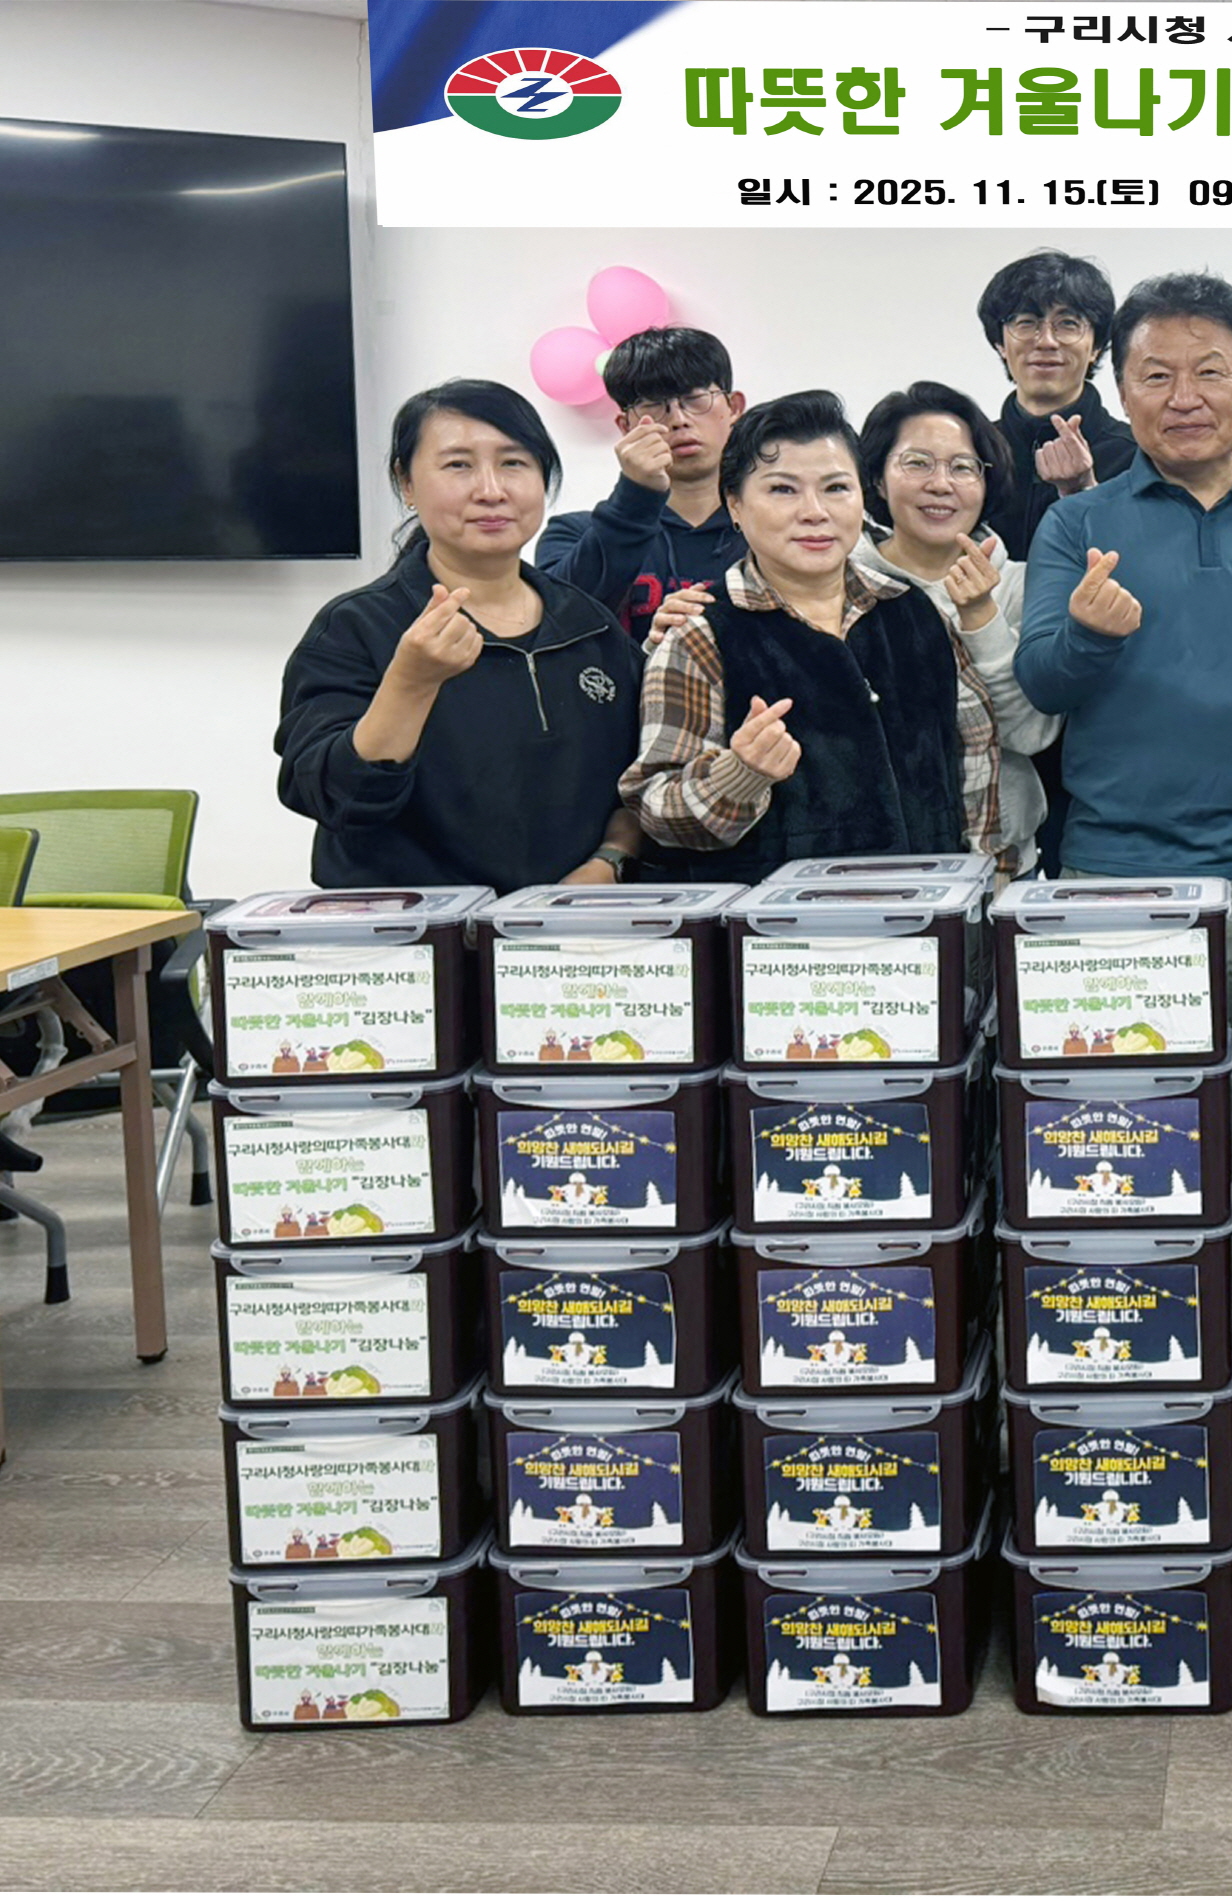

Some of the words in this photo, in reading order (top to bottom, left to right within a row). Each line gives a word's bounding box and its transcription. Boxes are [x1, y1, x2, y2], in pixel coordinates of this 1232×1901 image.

[1024, 15, 1206, 45] 구리시청
[684, 66, 907, 137] 따뜻한
[939, 66, 1231, 137] 겨울나기
[737, 178, 810, 206] 일시
[853, 179, 956, 206] 2025.
[973, 179, 1025, 205] 11.
